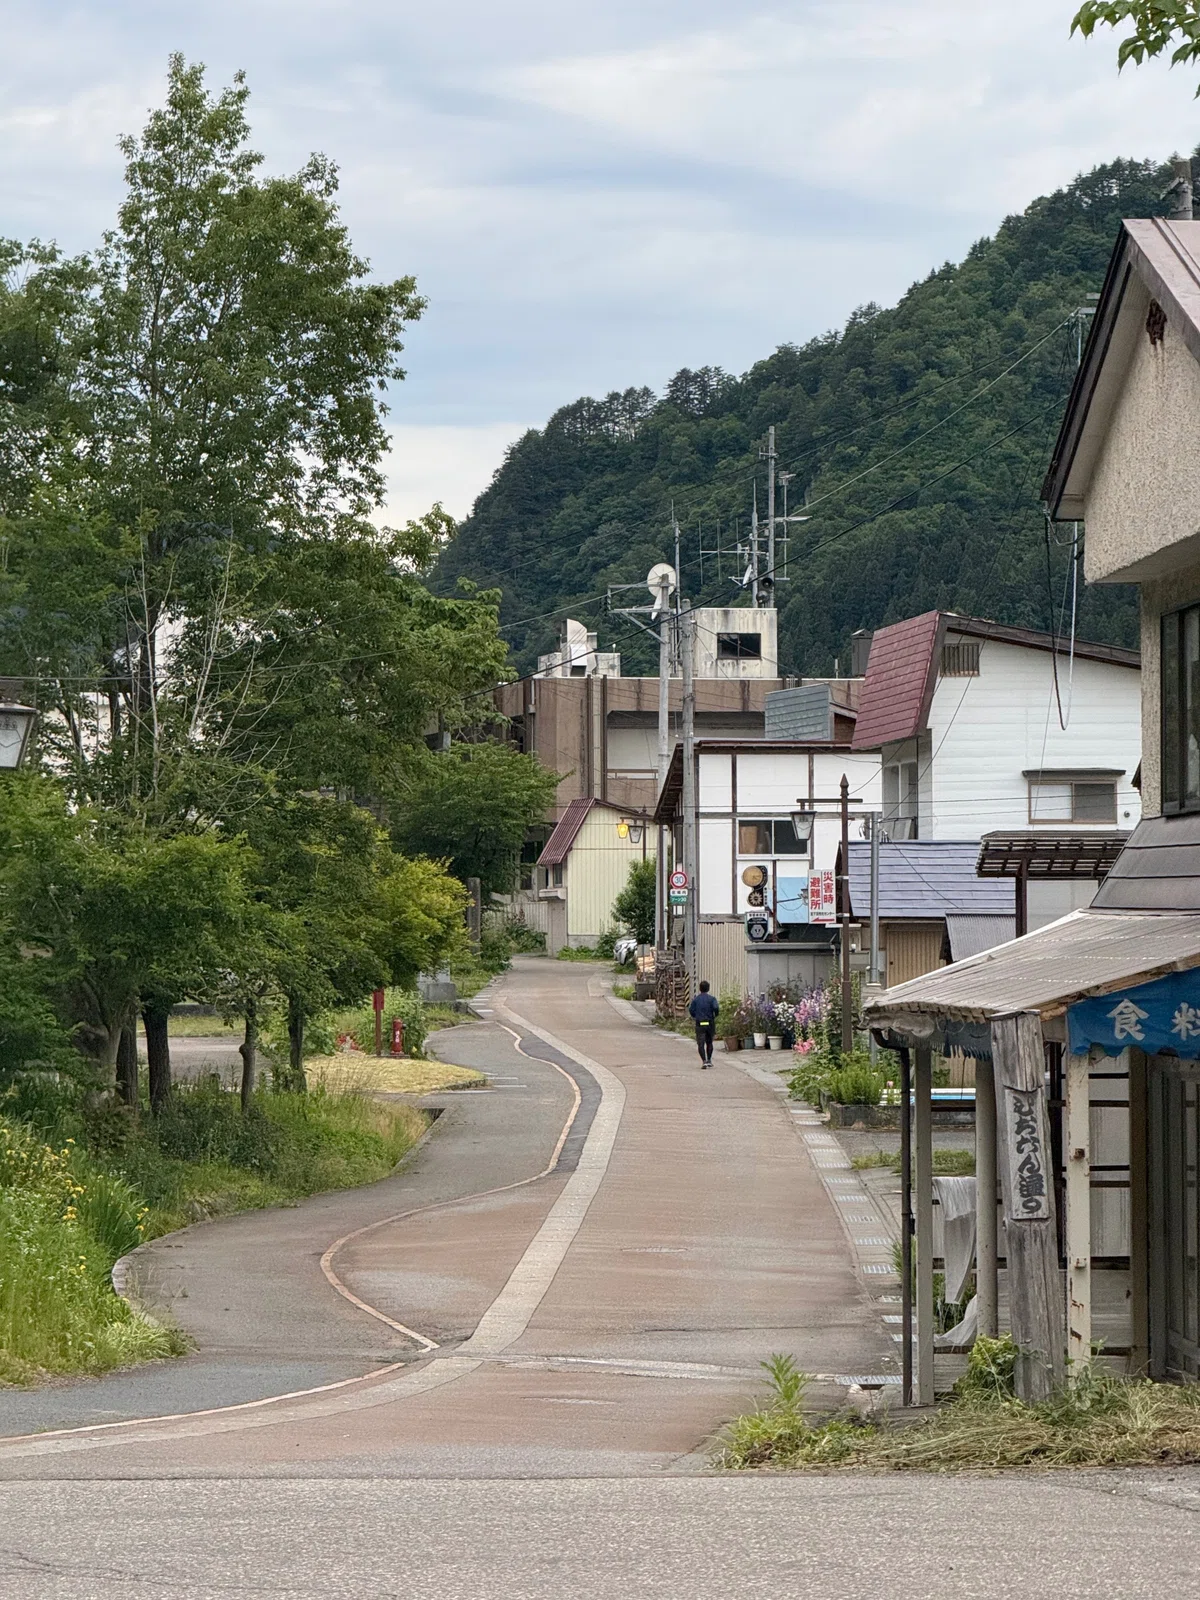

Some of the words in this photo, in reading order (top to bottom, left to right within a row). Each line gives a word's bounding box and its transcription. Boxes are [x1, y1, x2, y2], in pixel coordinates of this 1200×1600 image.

[674, 875, 684, 884] 30
[810, 877, 821, 910] 避難所
[823, 871, 834, 905] 災害時
